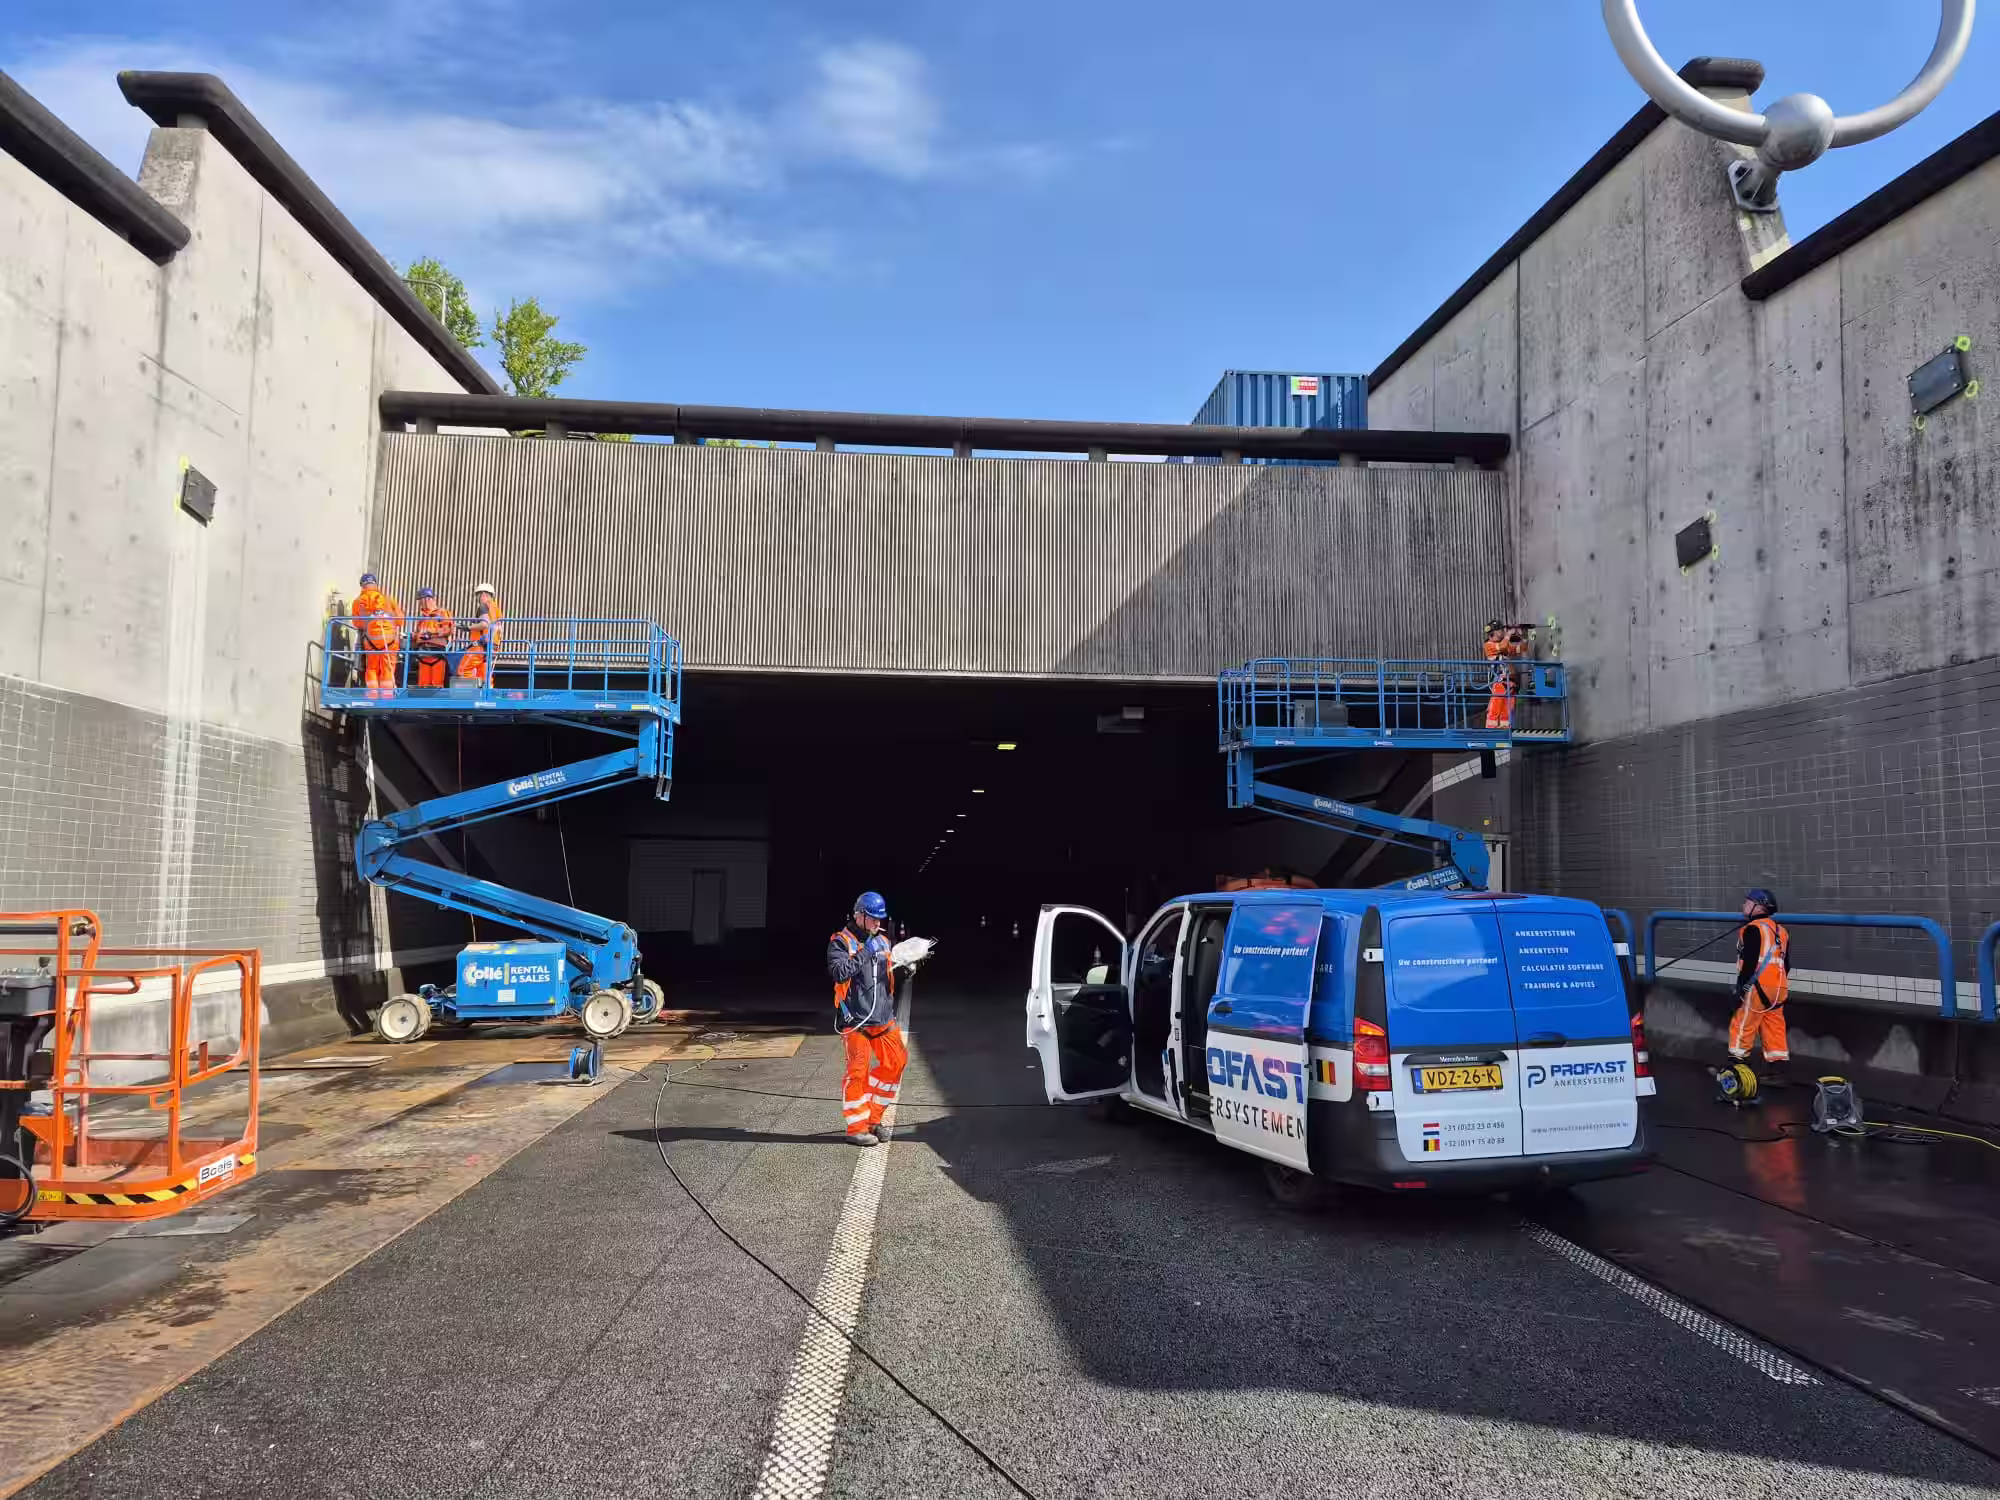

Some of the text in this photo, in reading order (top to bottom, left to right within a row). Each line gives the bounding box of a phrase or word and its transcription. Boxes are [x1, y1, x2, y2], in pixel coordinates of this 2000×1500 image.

[1243, 945, 1282, 956] constructieve
[510, 965, 550, 975] RENTAL
[1521, 963, 1605, 972] CALCULATIE SOFTWARE
[519, 974, 551, 984] SALES
[1524, 982, 1561, 990] TRAINING
[1550, 1060, 1627, 1077] PROFAST
[1426, 1067, 1497, 1087] VDZ-26-K
[1554, 1075, 1625, 1088] ANKERSYSTEMEN
